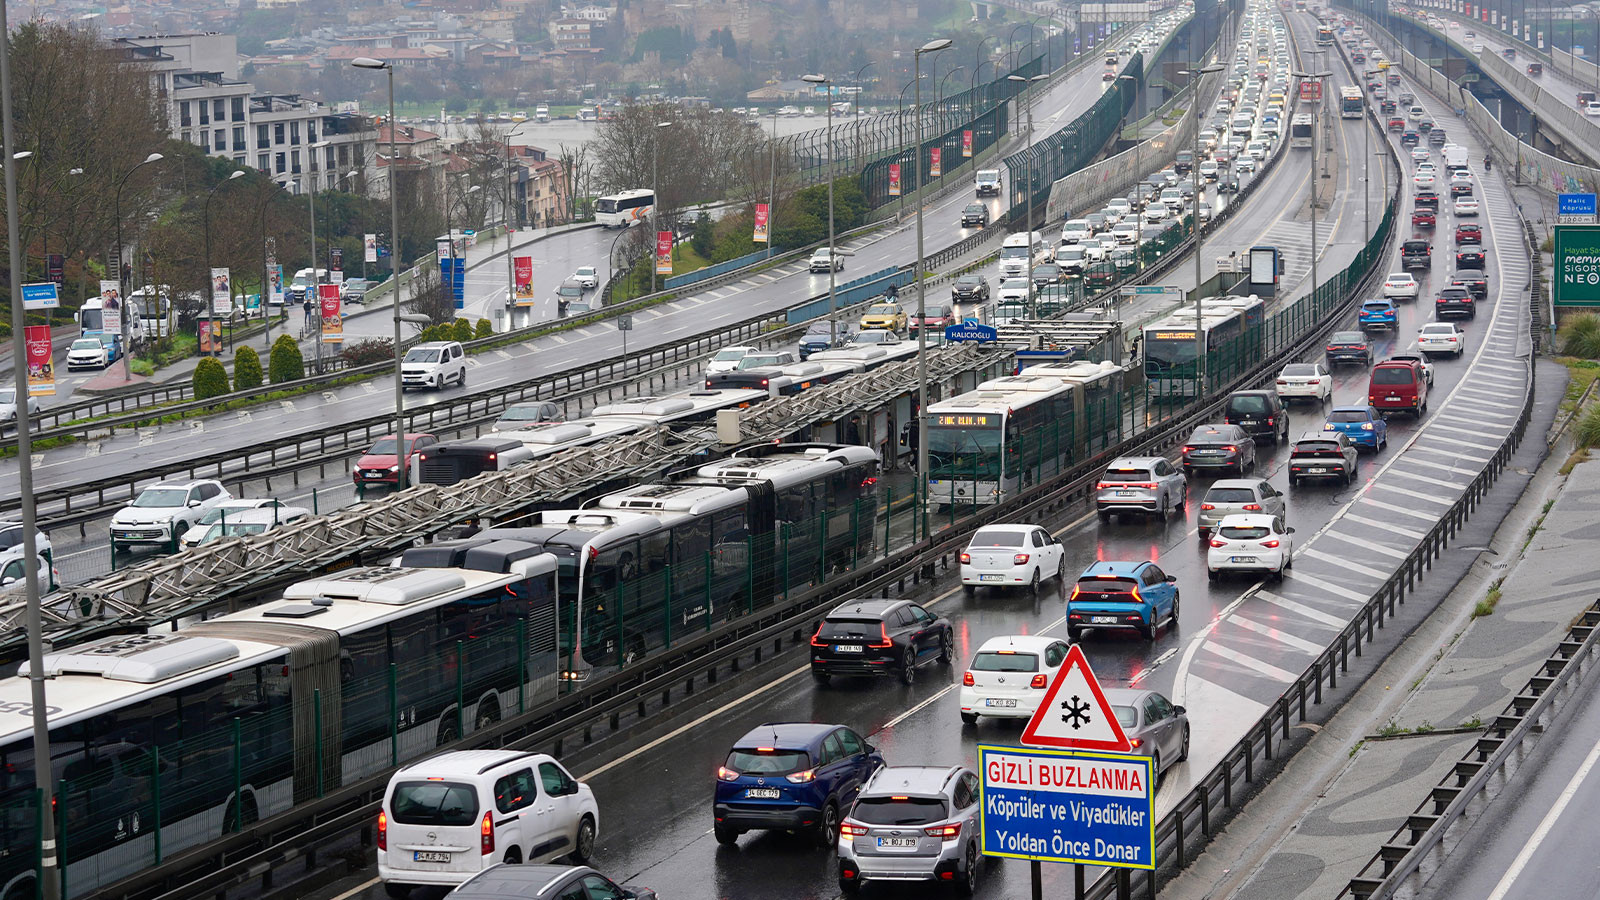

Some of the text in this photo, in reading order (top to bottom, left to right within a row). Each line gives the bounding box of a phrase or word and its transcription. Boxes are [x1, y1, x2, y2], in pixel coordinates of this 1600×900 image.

[1564, 247, 1588, 255] Hayat
[988, 757, 1143, 792] GİZLİ BUZLANMA
[987, 794, 1145, 828] Köprüler ve Viyadükler
[996, 829, 1141, 861] Yoldan Önce Donar
